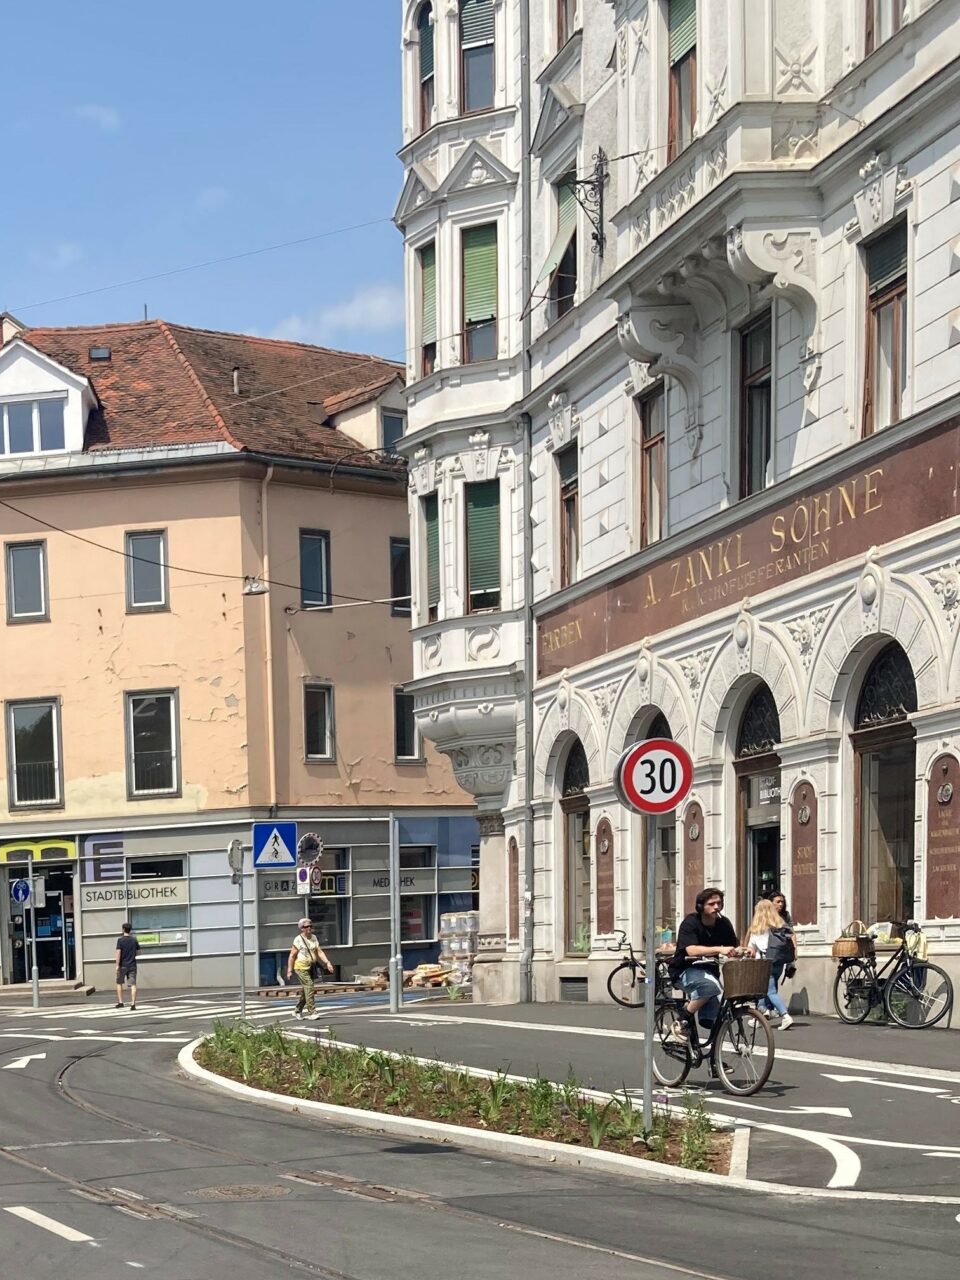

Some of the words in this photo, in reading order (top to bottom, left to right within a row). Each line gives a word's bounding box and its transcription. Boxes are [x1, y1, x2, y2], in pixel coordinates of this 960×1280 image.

[670, 533, 751, 598] ZANKL
[769, 467, 884, 553] SÖHNE
[640, 757, 676, 795] 30
[86, 887, 177, 902] STADTBIBLIOTHEK
[372, 877, 416, 888] MEDHEK
